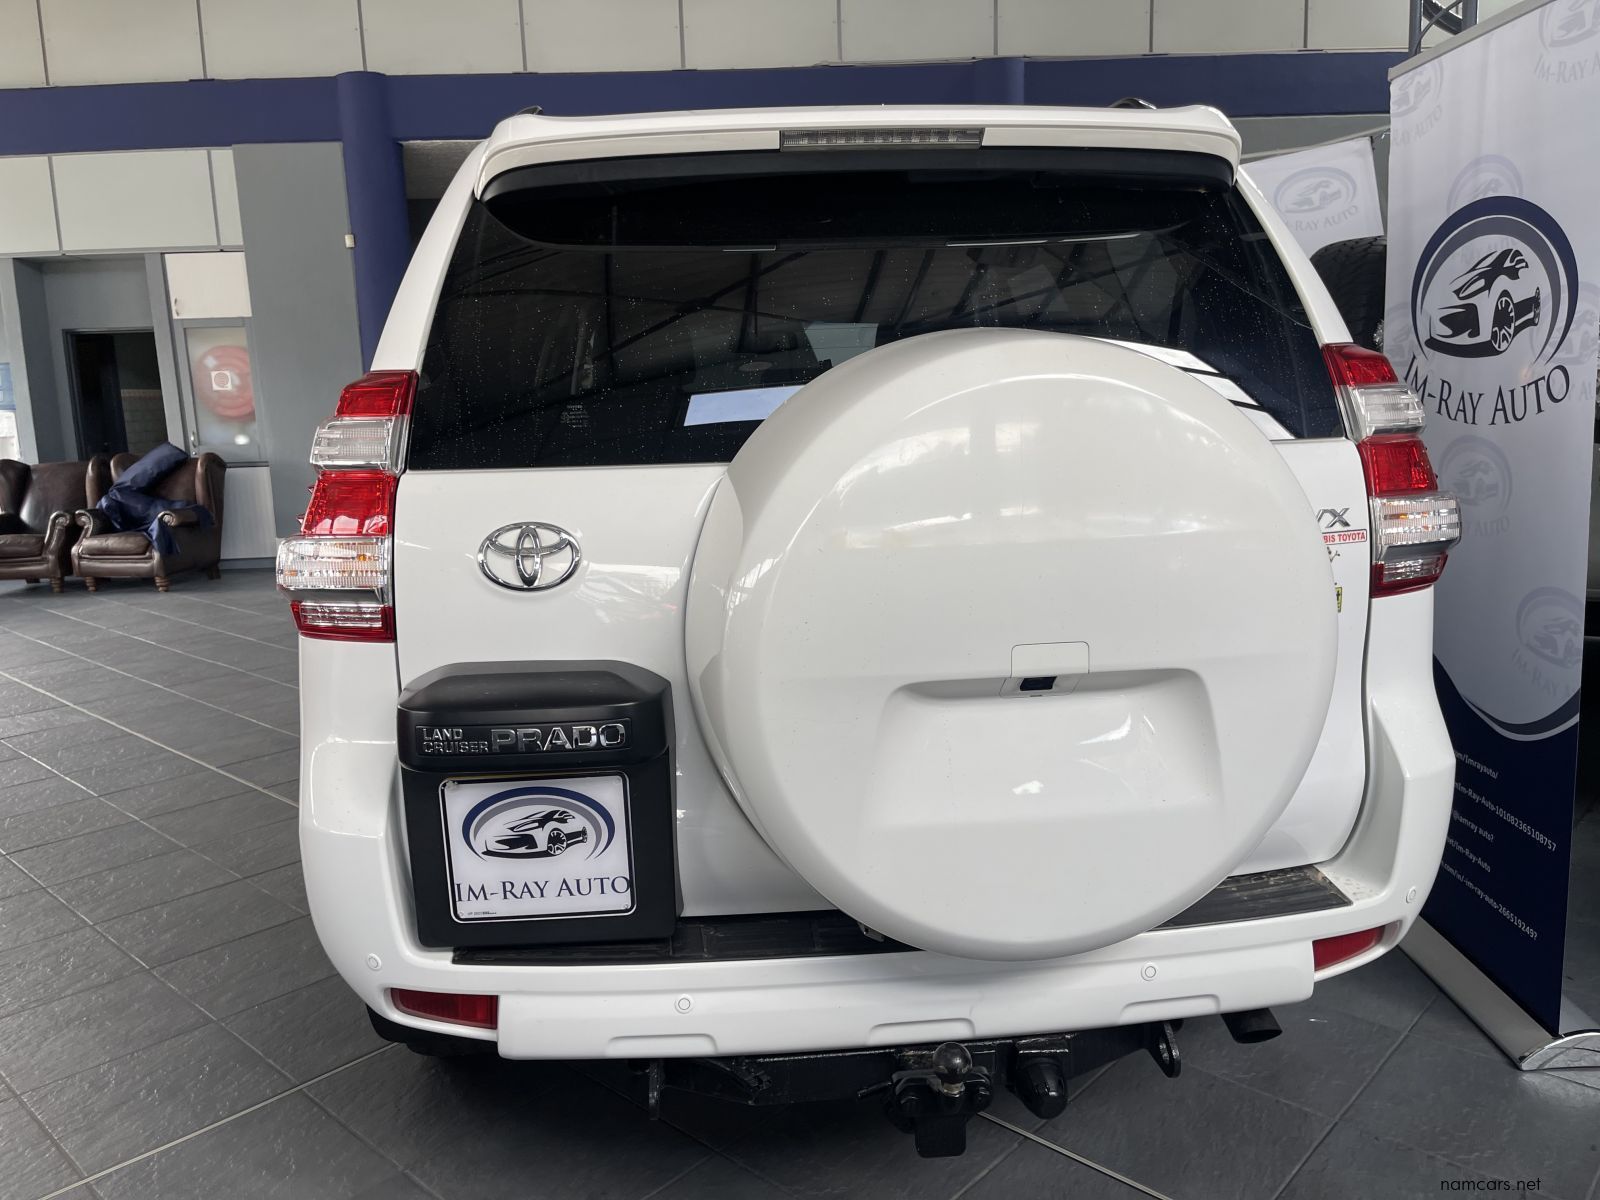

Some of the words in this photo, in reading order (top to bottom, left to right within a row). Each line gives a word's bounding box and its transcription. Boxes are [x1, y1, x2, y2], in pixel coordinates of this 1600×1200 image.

[1403, 352, 1485, 426] IM-RAY
[1488, 365, 1570, 426] AUTO
[1337, 531, 1366, 543] TOYOTA
[423, 728, 463, 741] LAND
[490, 723, 626, 752] PRADO
[423, 741, 489, 753] CRUISER
[455, 880, 550, 903] IM-RAY
[557, 875, 630, 898] AUTO
